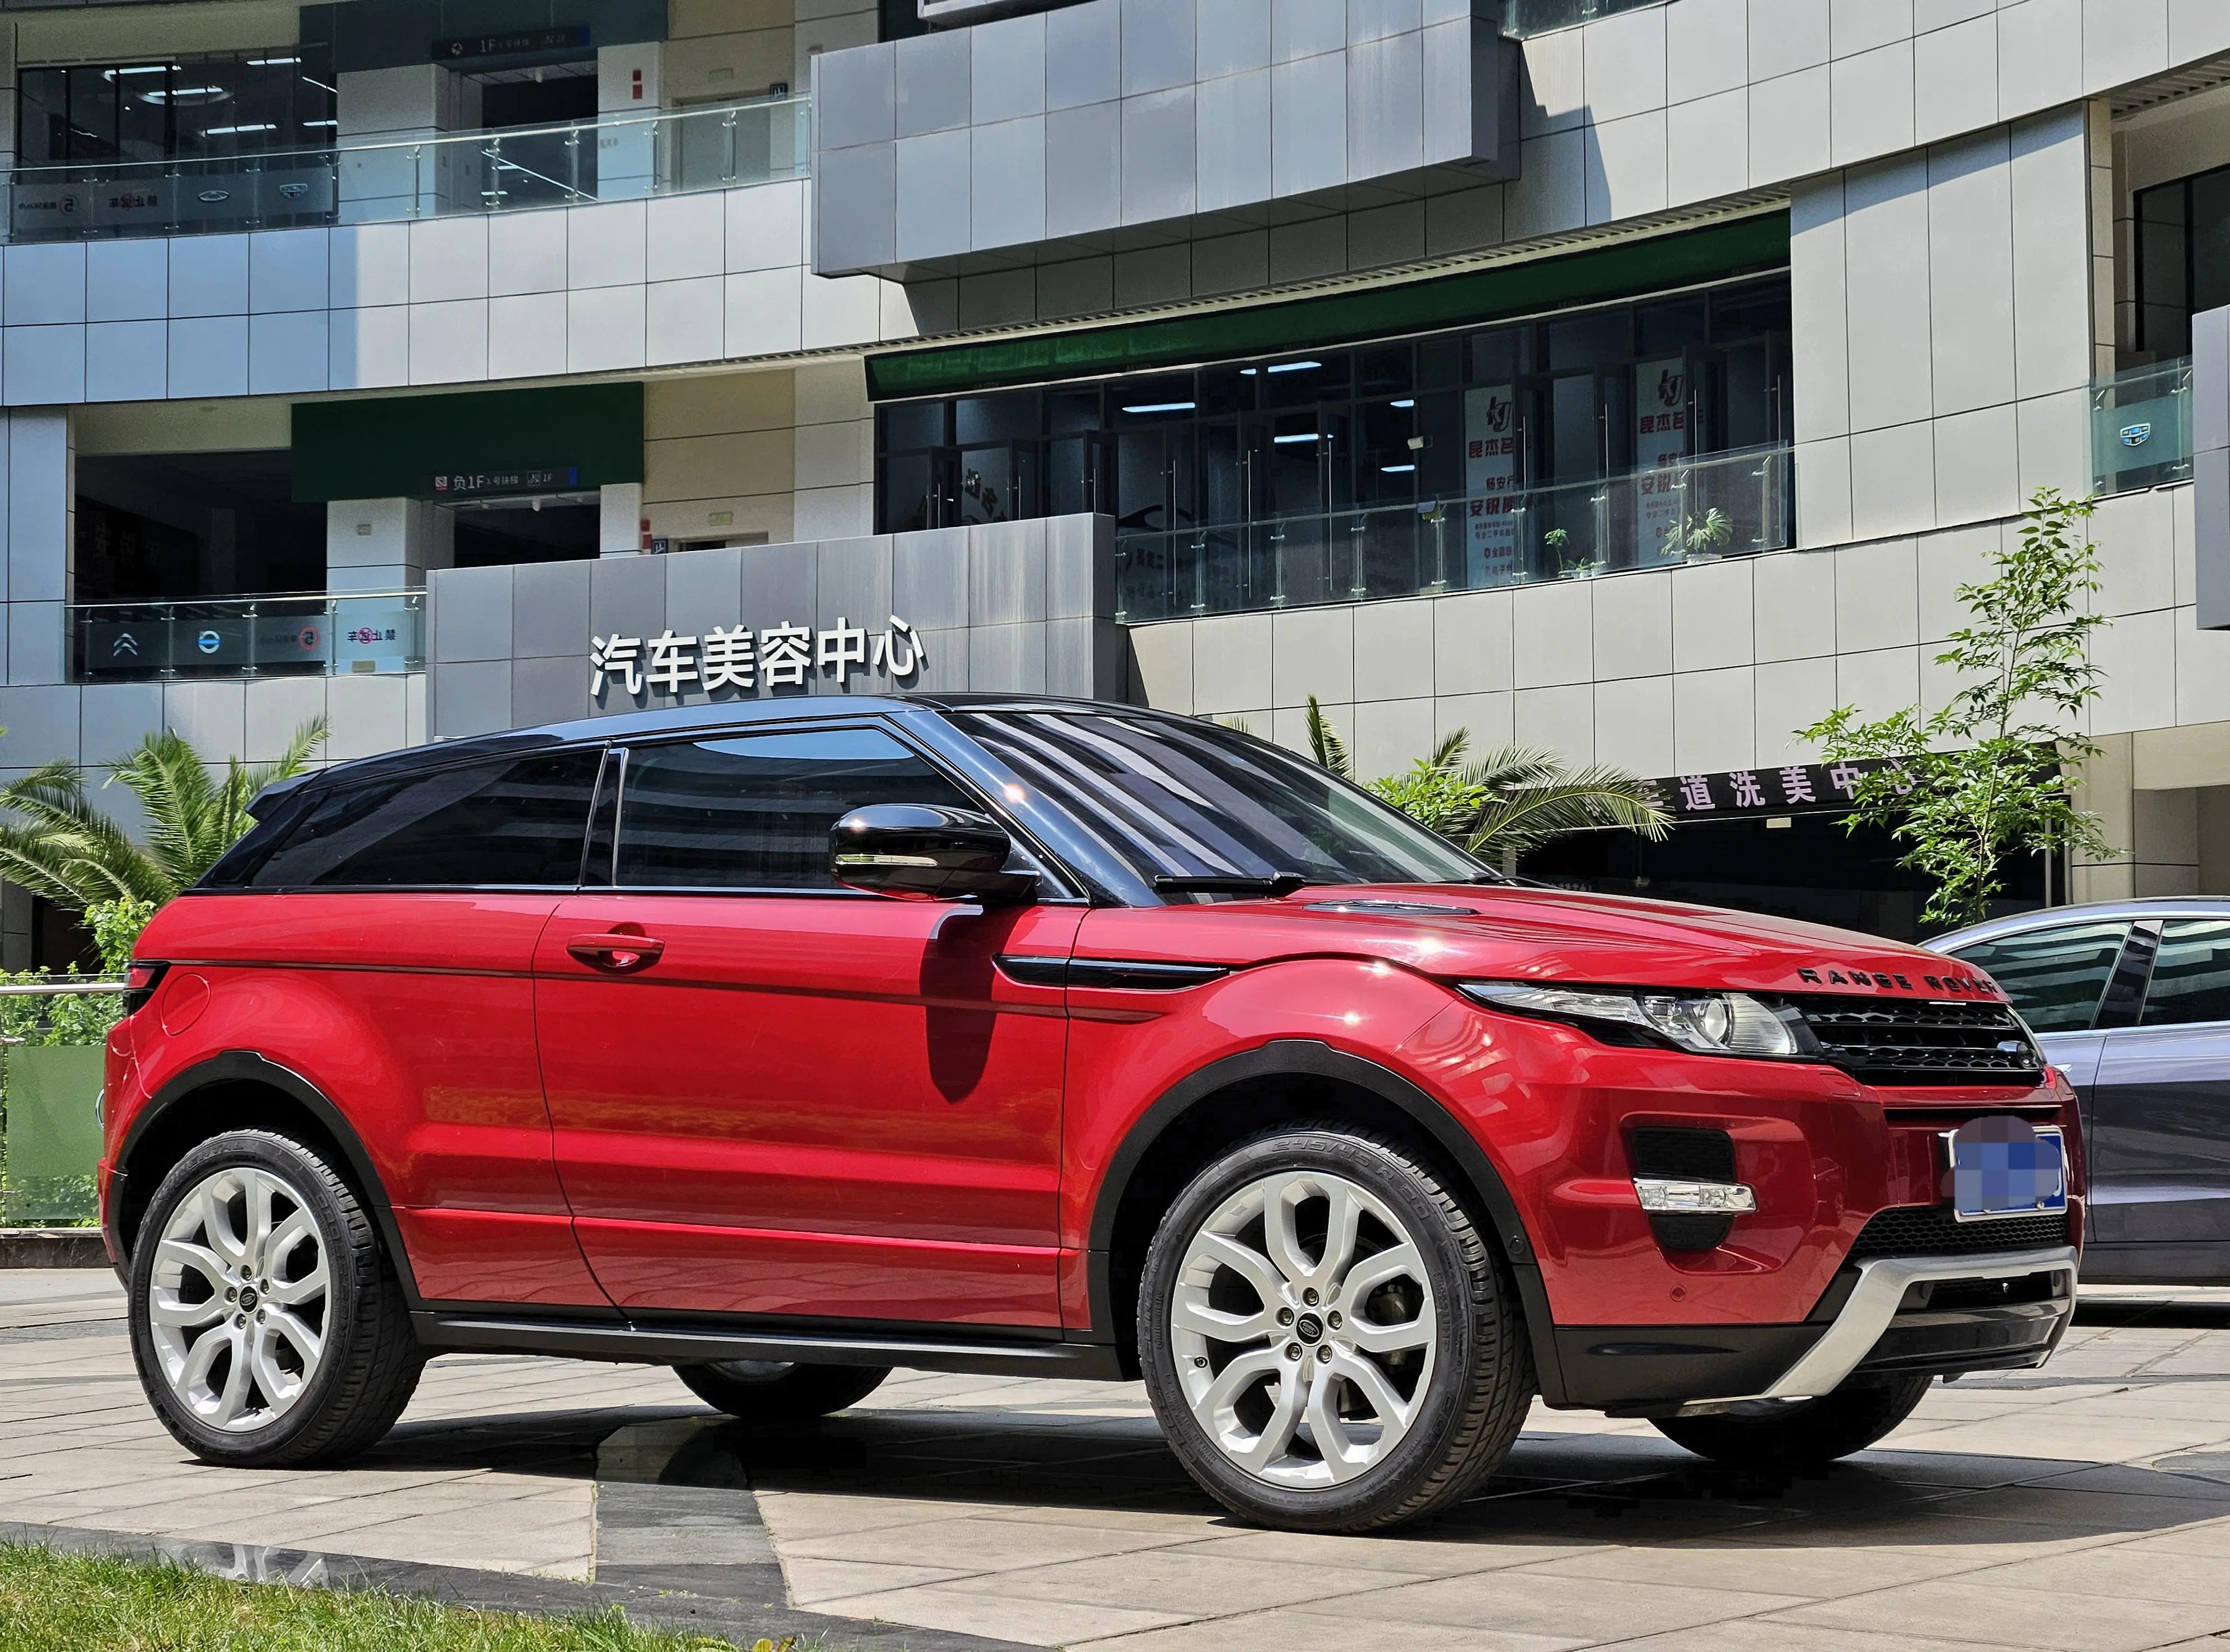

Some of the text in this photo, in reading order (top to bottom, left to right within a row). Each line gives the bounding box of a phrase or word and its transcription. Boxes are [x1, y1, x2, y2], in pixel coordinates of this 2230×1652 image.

[1469, 437, 1532, 458] 昆杰名
[453, 475, 485, 491] 负1F
[590, 615, 925, 697] 汽车美容中心
[1796, 967, 1998, 994] RANGE ROVER
[1272, 1139, 1372, 1167] 245/45
[1377, 1166, 1395, 1182] R
[1398, 1184, 1430, 1219] 20
